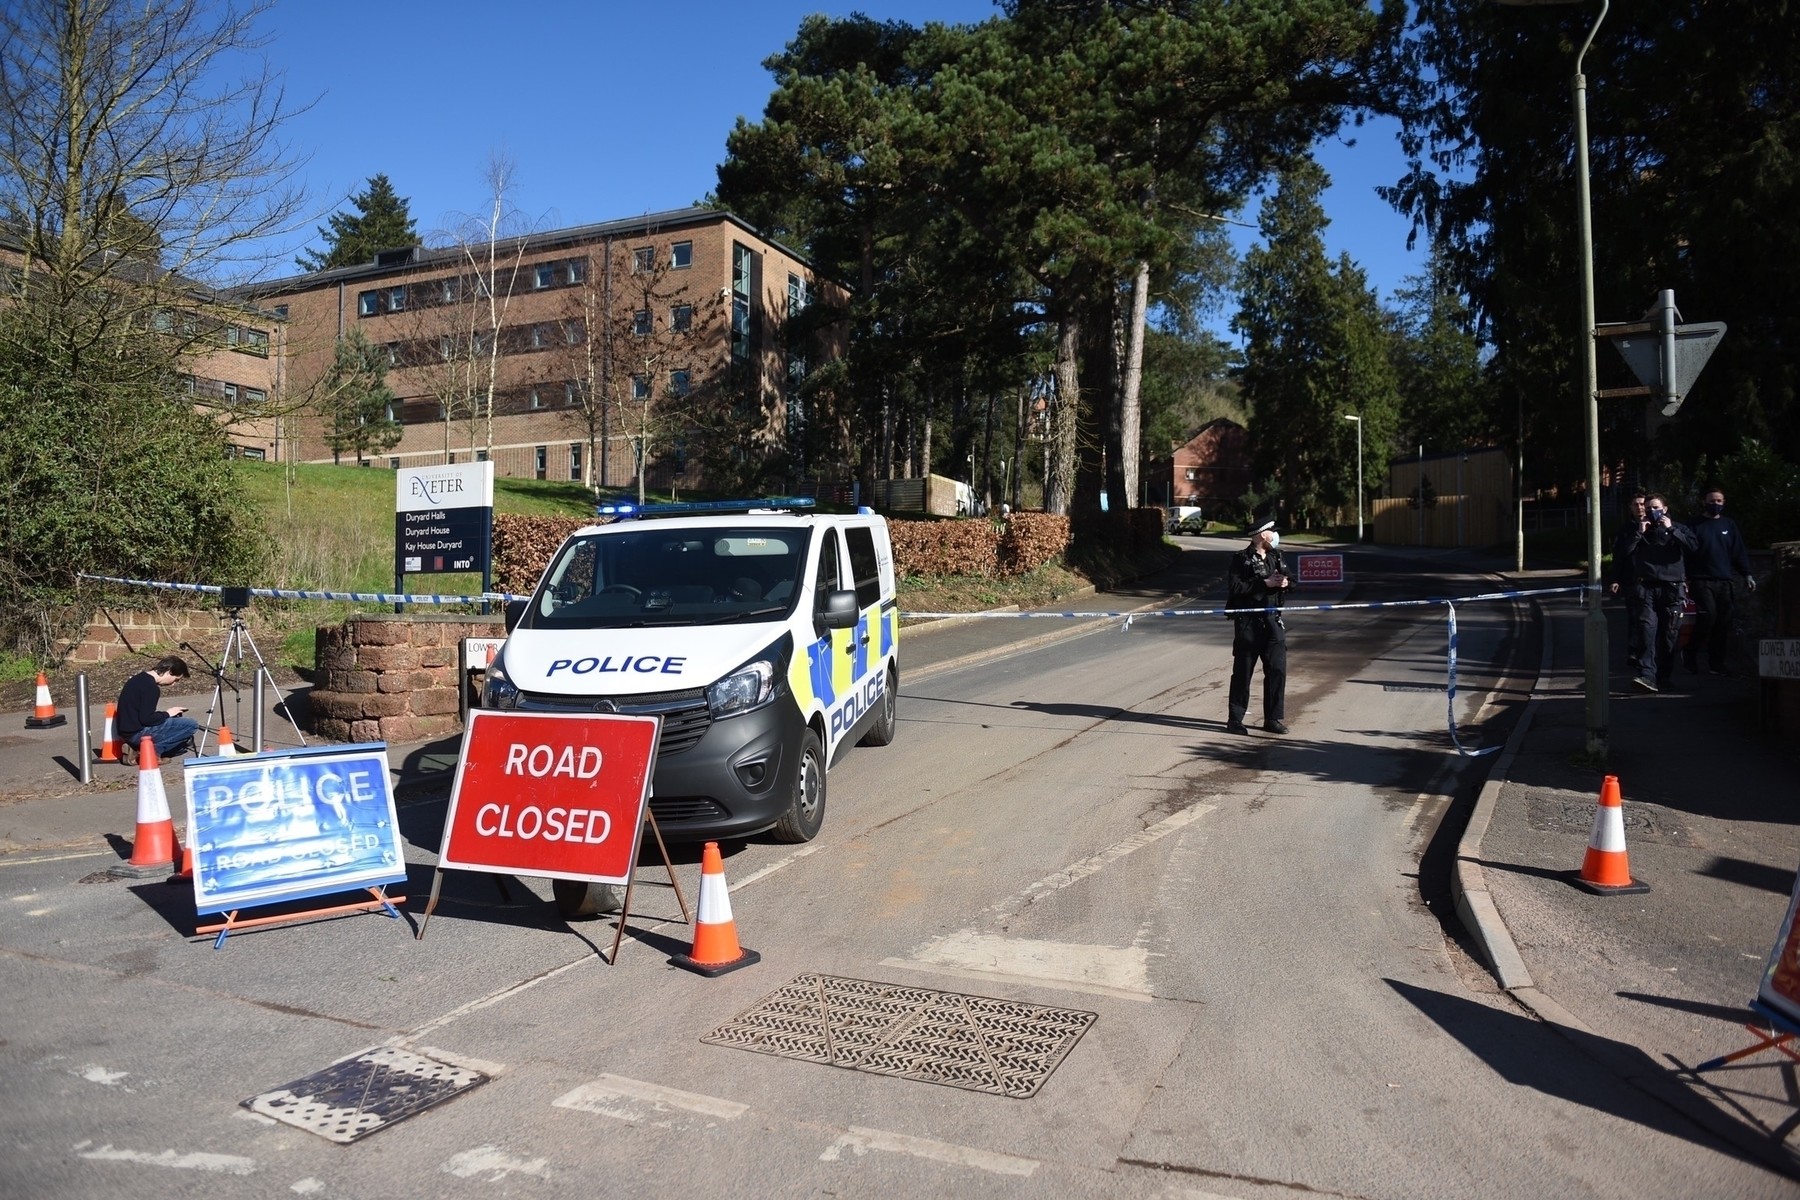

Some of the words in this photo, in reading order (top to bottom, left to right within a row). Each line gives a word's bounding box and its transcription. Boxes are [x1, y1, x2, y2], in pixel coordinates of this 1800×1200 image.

[410, 477, 465, 500] EXETER
[405, 513, 430, 523] Duryard
[431, 511, 446, 520] Halls
[405, 527, 430, 538] Duryard
[430, 526, 450, 535] House
[405, 542, 416, 552] Kay
[417, 541, 436, 550] House
[437, 540, 462, 551] Duryard
[453, 560, 470, 569] INTO
[1307, 560, 1333, 568] ROAD
[1302, 569, 1338, 577] CLOSED
[1760, 641, 1785, 656] LOWER
[546, 656, 687, 677] POLICE
[831, 669, 884, 744] POLICE
[505, 743, 603, 779] ROAD
[207, 771, 374, 819] POLICE
[475, 803, 612, 845] CLOSED
